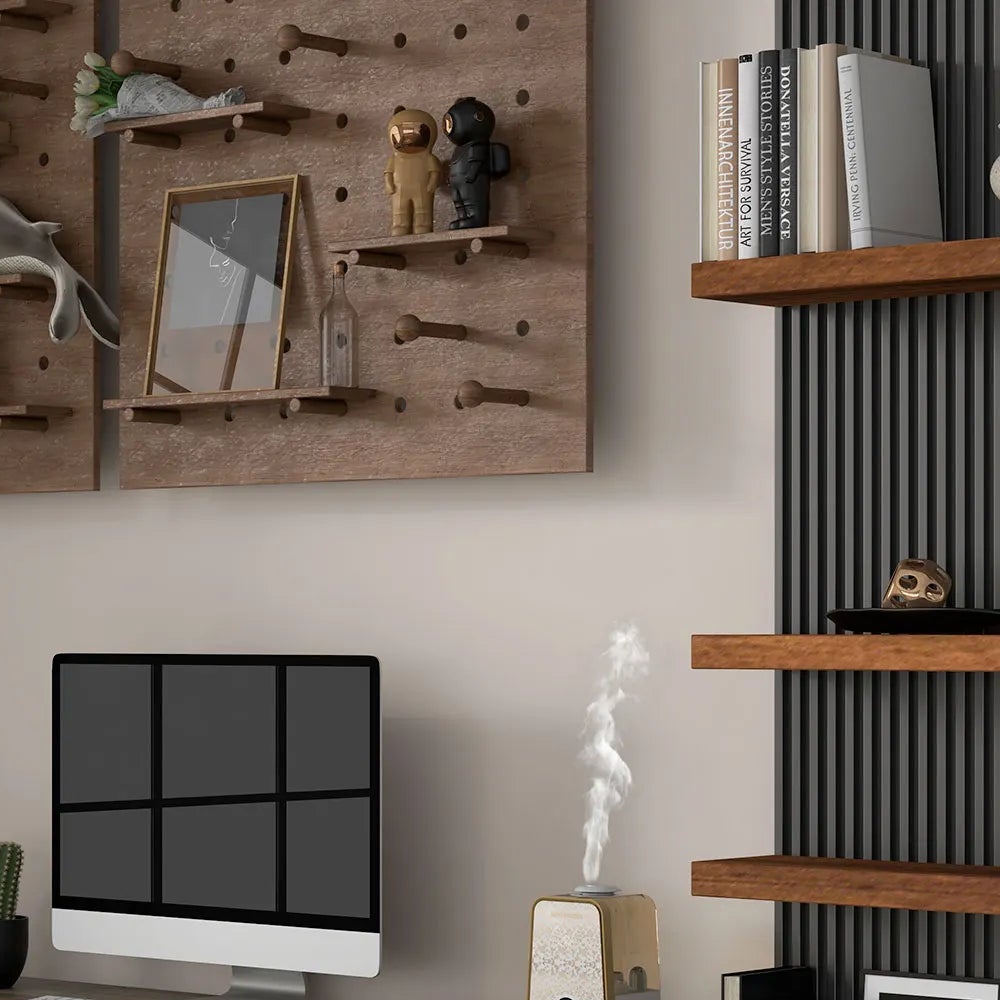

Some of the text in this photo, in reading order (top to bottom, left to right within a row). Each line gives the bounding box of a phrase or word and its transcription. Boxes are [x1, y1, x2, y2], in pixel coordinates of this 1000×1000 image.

[718, 88, 734, 250] INNENARCHITEKTUR
[760, 65, 773, 236] MEN'S STYLE STORIES
[780, 65, 791, 240] DONATELLA VERSACE
[844, 88, 856, 150] CENTENNIAL
[740, 138, 751, 247] ART FOR SURVIVAL
[850, 184, 861, 222] IRVING
